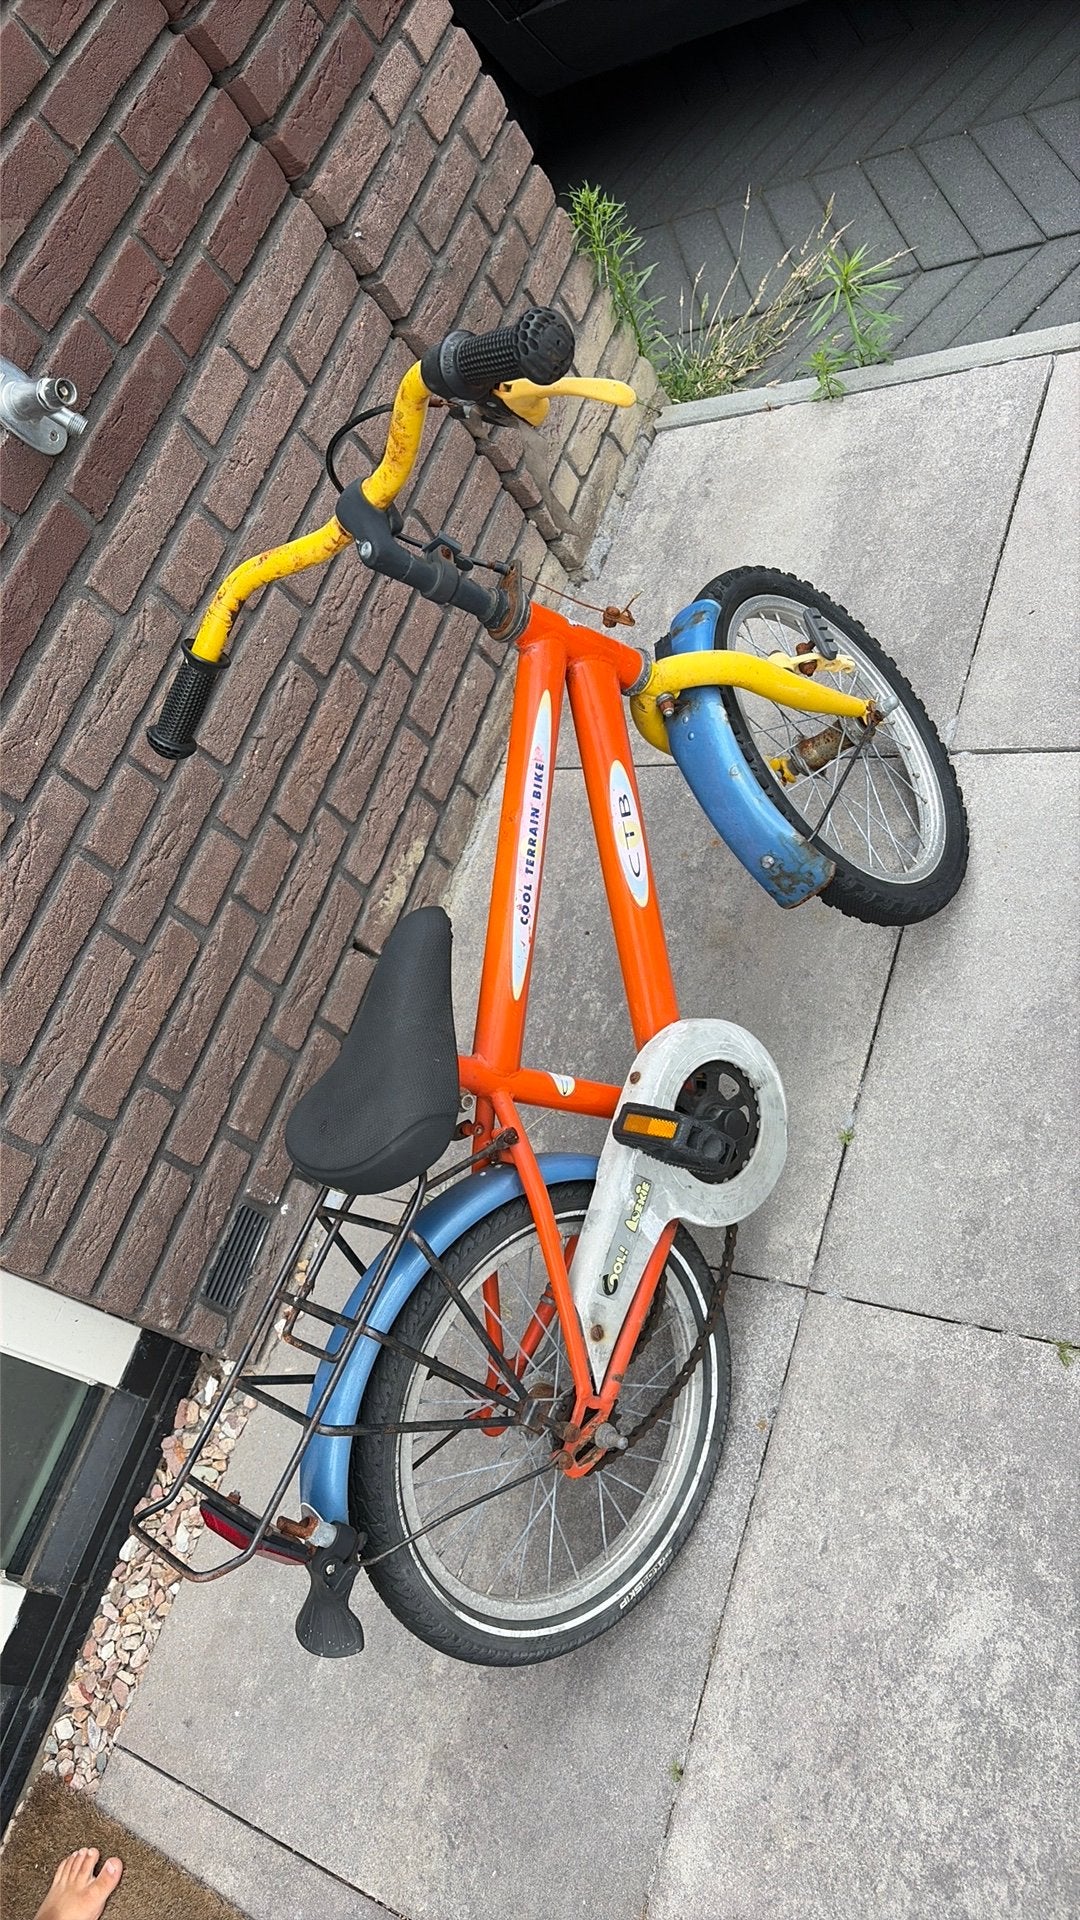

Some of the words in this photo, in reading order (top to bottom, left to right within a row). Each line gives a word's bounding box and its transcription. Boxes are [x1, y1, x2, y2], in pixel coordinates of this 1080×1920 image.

[532, 763, 545, 800] BIKE
[525, 807, 541, 875] TERRAIN
[618, 793, 641, 878] CTB
[520, 884, 533, 925] COOL
